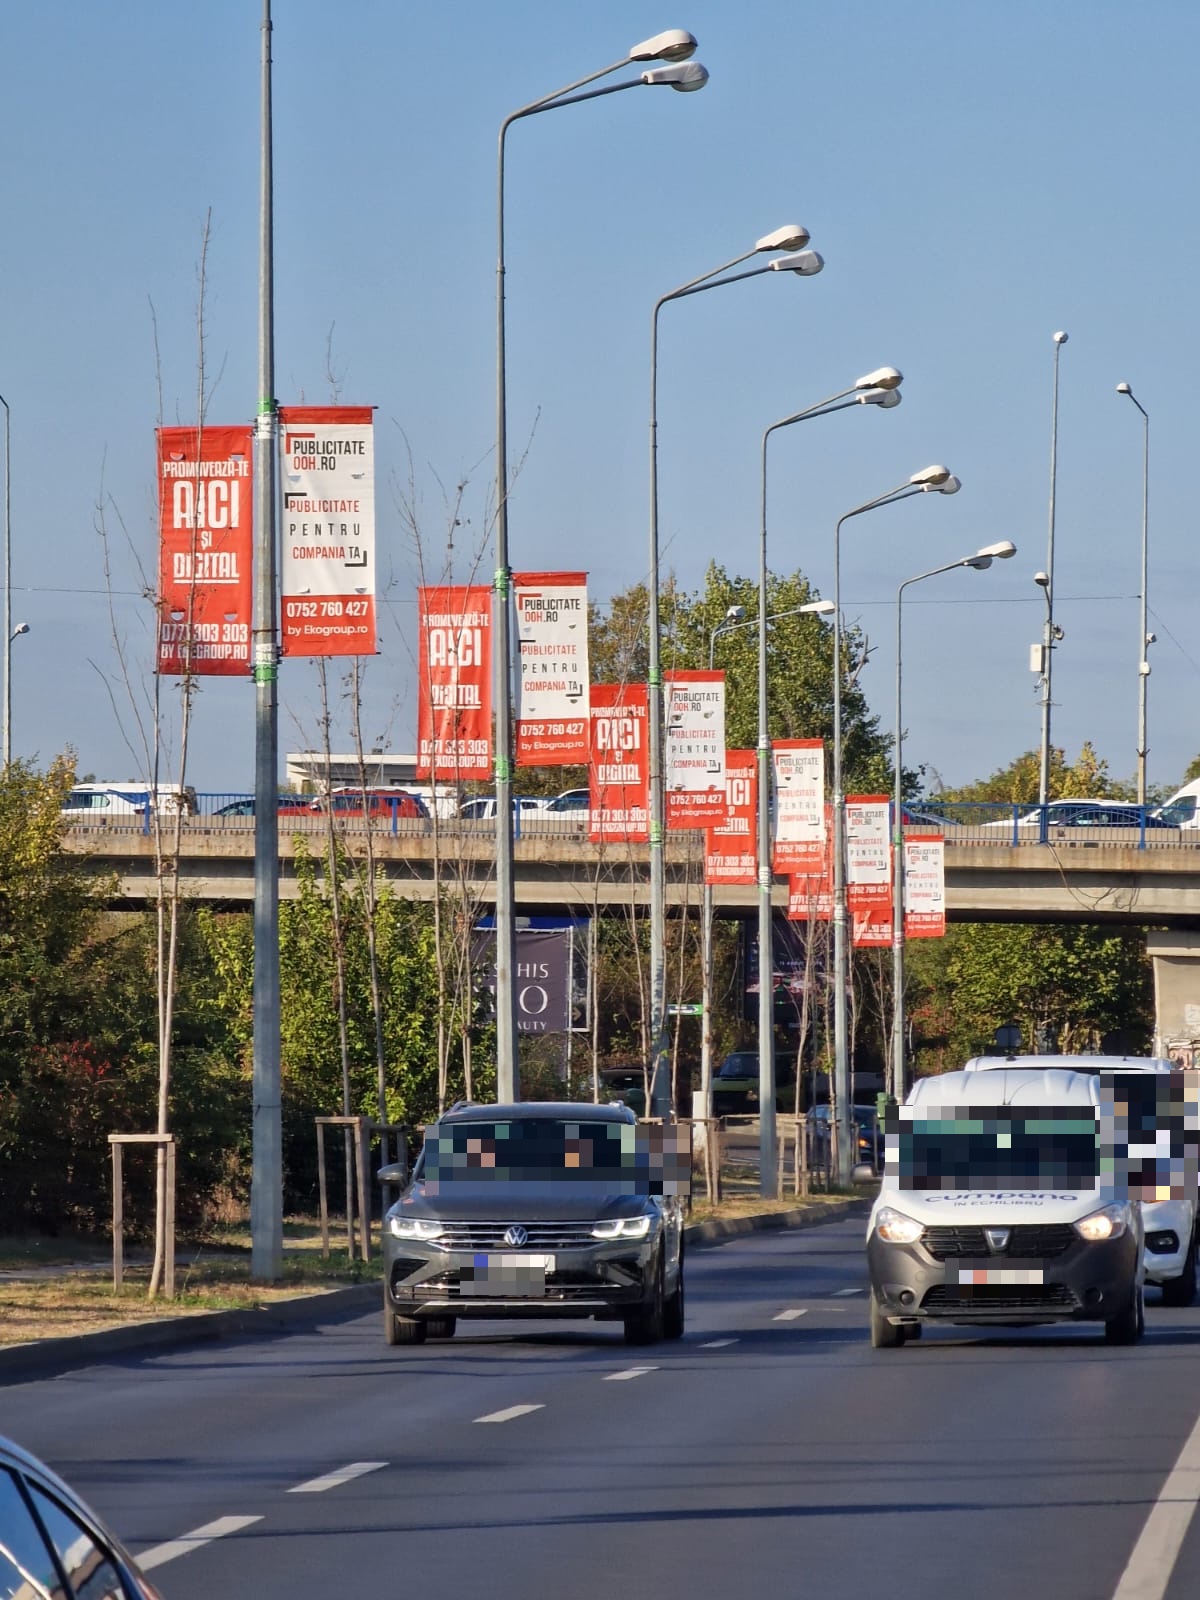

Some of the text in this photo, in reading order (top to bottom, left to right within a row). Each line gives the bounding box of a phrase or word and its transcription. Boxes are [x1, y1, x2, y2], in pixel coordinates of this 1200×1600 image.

[294, 440, 365, 454] PUBLICITATE
[293, 456, 336, 470] OOH.RO
[173, 480, 240, 528] AICI
[290, 500, 360, 512] PUBLICITATE
[290, 523, 360, 536] PENTRU
[292, 546, 360, 559] COMPANIA TA
[173, 552, 240, 578] DIGITAL
[286, 601, 368, 617] 0752 760 427
[524, 598, 581, 610] PUBLICITATE
[524, 611, 558, 622] OOH.RO
[194, 624, 219, 642] 303
[222, 624, 248, 642] 303
[288, 624, 368, 637] by Ekogroup.ro
[161, 644, 174, 659] BY
[430, 629, 482, 666] AICI
[522, 645, 576, 655] PUBLICITATE
[522, 663, 577, 673] PENTRU
[524, 681, 578, 692] COMPANIA TA
[674, 692, 720, 702] PUBLICITATE
[521, 723, 584, 736] 0752 760 427
[597, 719, 640, 749] AICI
[672, 730, 716, 739] PUBLICITATE
[468, 740, 488, 754] 303
[521, 742, 532, 751] by
[671, 745, 716, 753] PENTRU
[674, 760, 716, 768] COMPANIA TA
[780, 758, 819, 766] PUBLICITATE
[726, 779, 750, 805] ICI
[670, 795, 689, 805] 0752
[708, 794, 723, 804] 427
